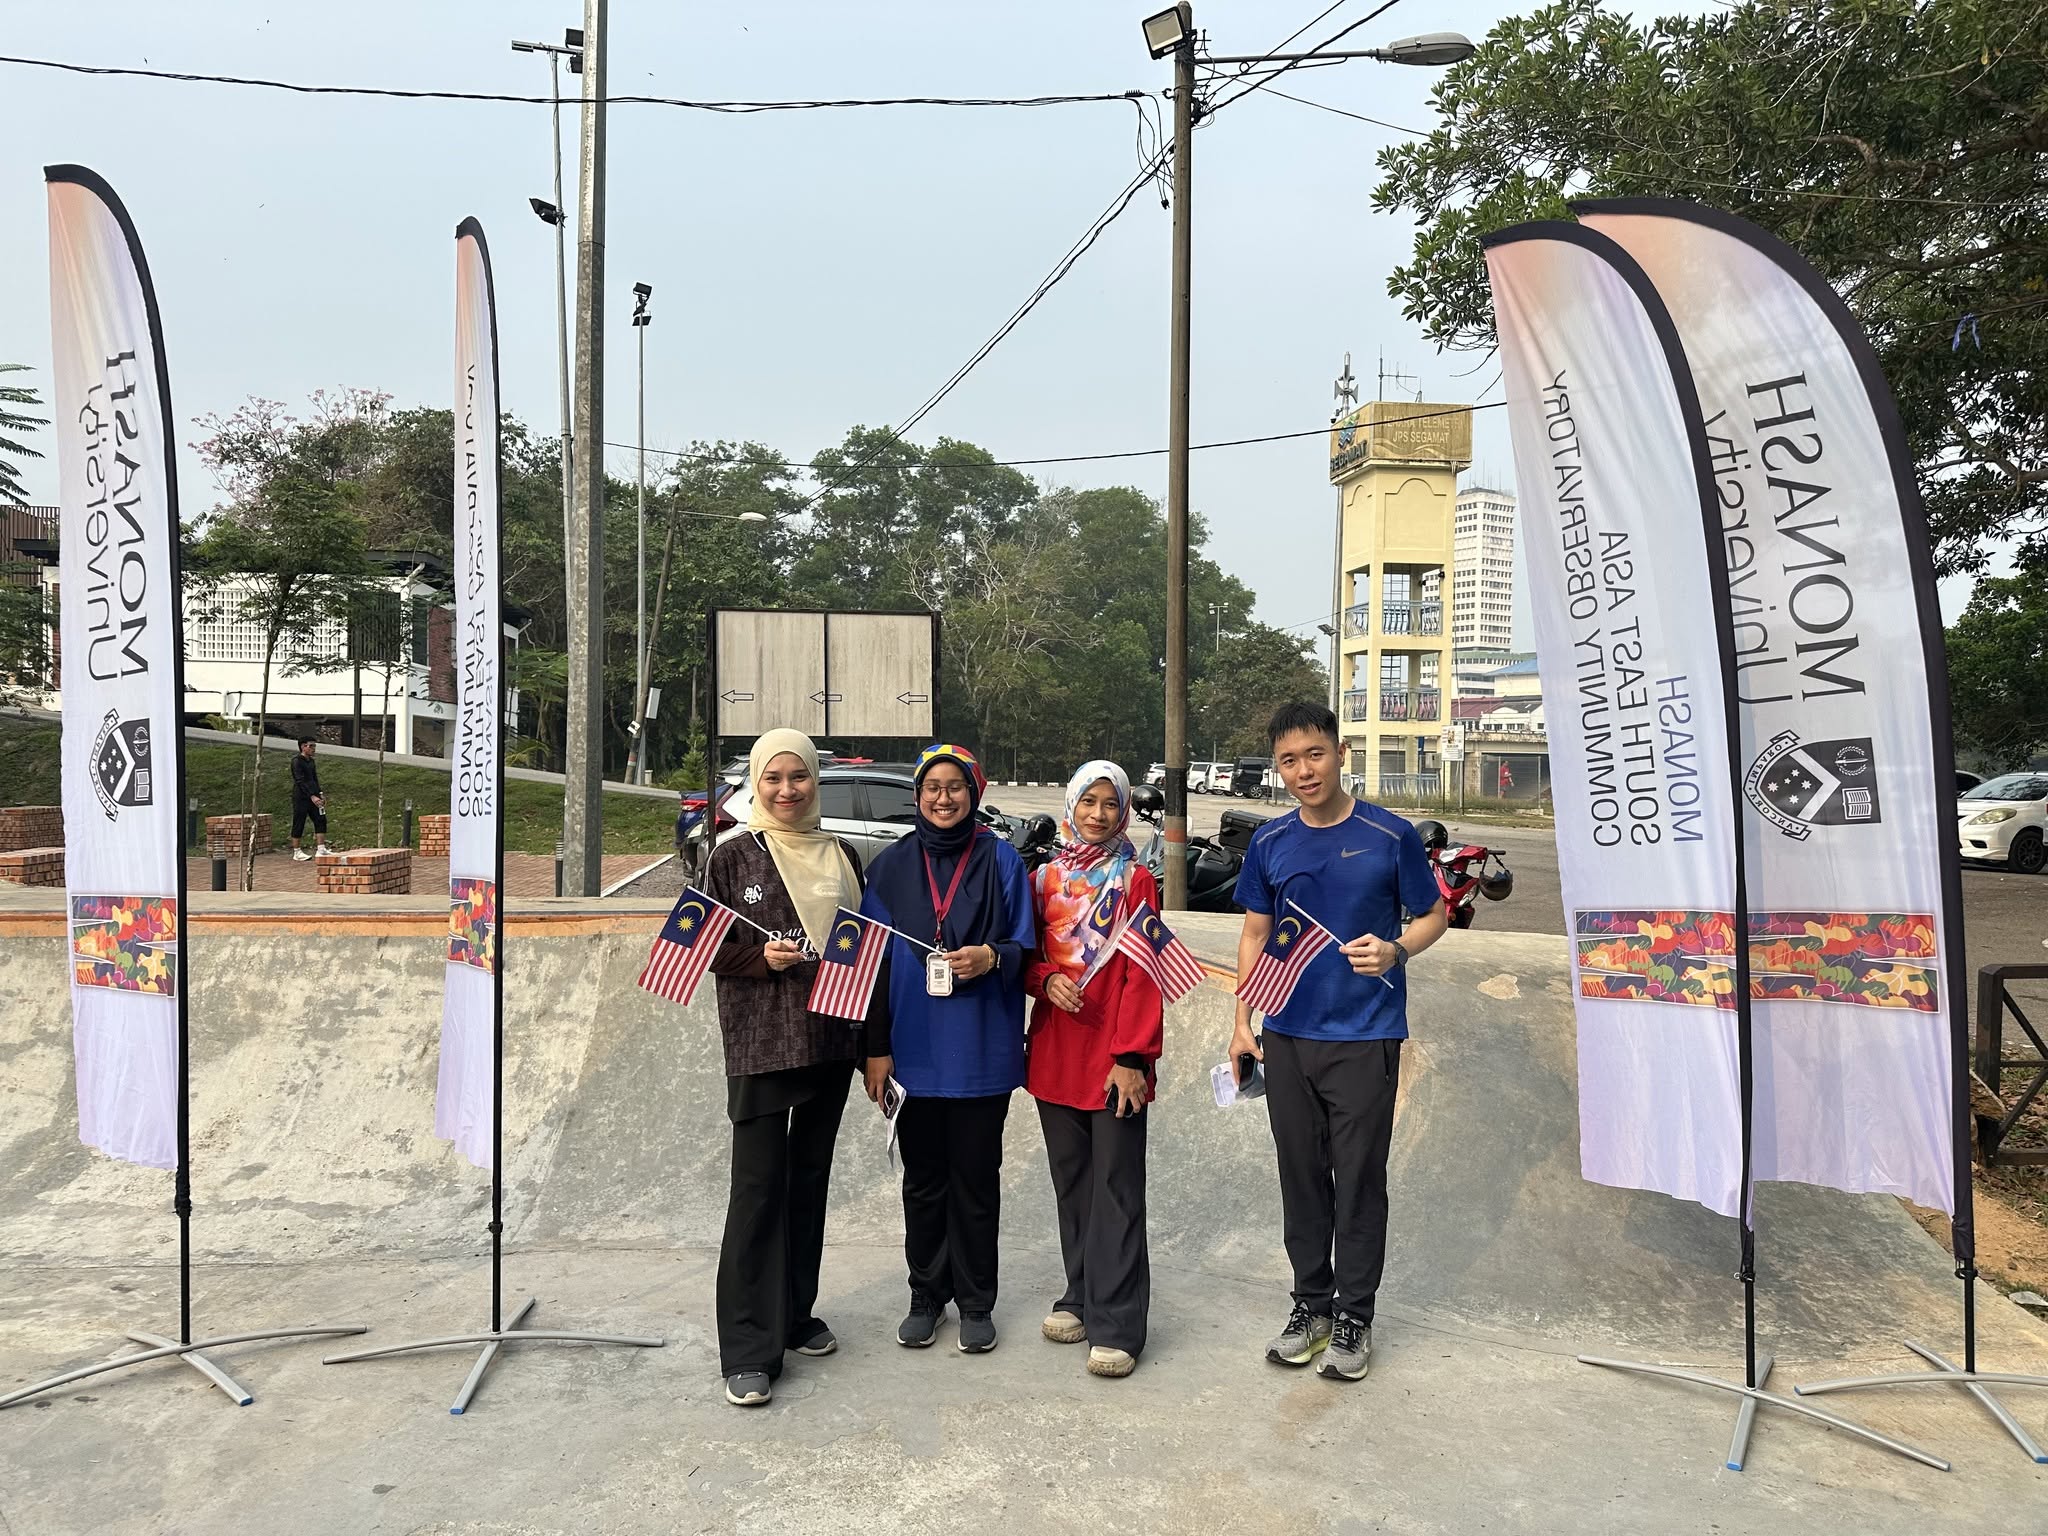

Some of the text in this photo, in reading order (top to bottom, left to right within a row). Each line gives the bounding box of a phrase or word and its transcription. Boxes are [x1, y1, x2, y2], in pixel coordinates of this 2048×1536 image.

[1393, 431, 1450, 444] JPS SEGAMAT
[783, 928, 803, 937] All
